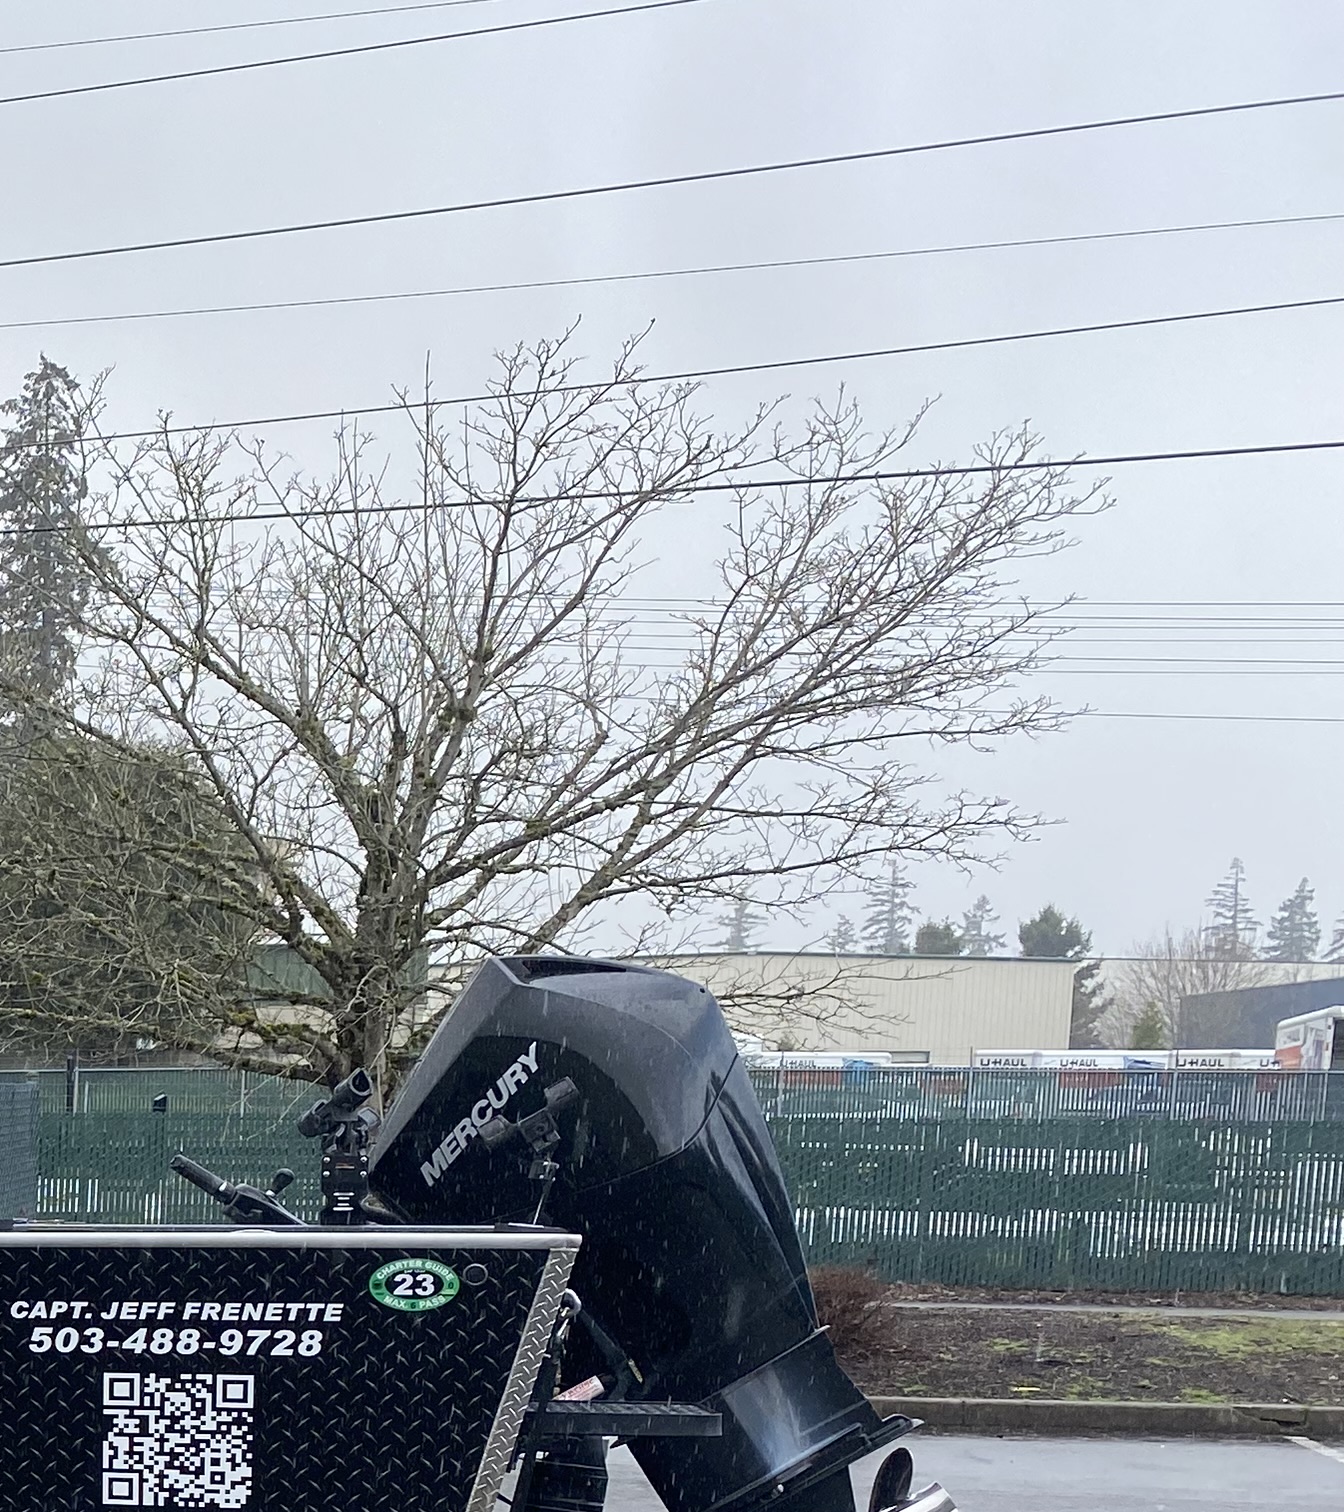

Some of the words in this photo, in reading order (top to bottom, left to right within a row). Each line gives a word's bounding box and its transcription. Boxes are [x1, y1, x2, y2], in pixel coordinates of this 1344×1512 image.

[980, 1058, 1027, 1067] U-HAUL
[1060, 1058, 1098, 1067] U-HAUL
[1177, 1058, 1224, 1067] U-HAUL
[420, 1041, 539, 1187] MERCURY
[376, 1260, 423, 1280] CHARTER
[425, 1261, 455, 1281] GUIDE
[393, 1273, 435, 1296] 23
[10, 1300, 93, 1320] CAPT.
[100, 1301, 177, 1321] JEFF
[182, 1302, 345, 1322] FRENETTE
[418, 1295, 446, 1309] PASS
[28, 1326, 324, 1357] 503-488-9728
